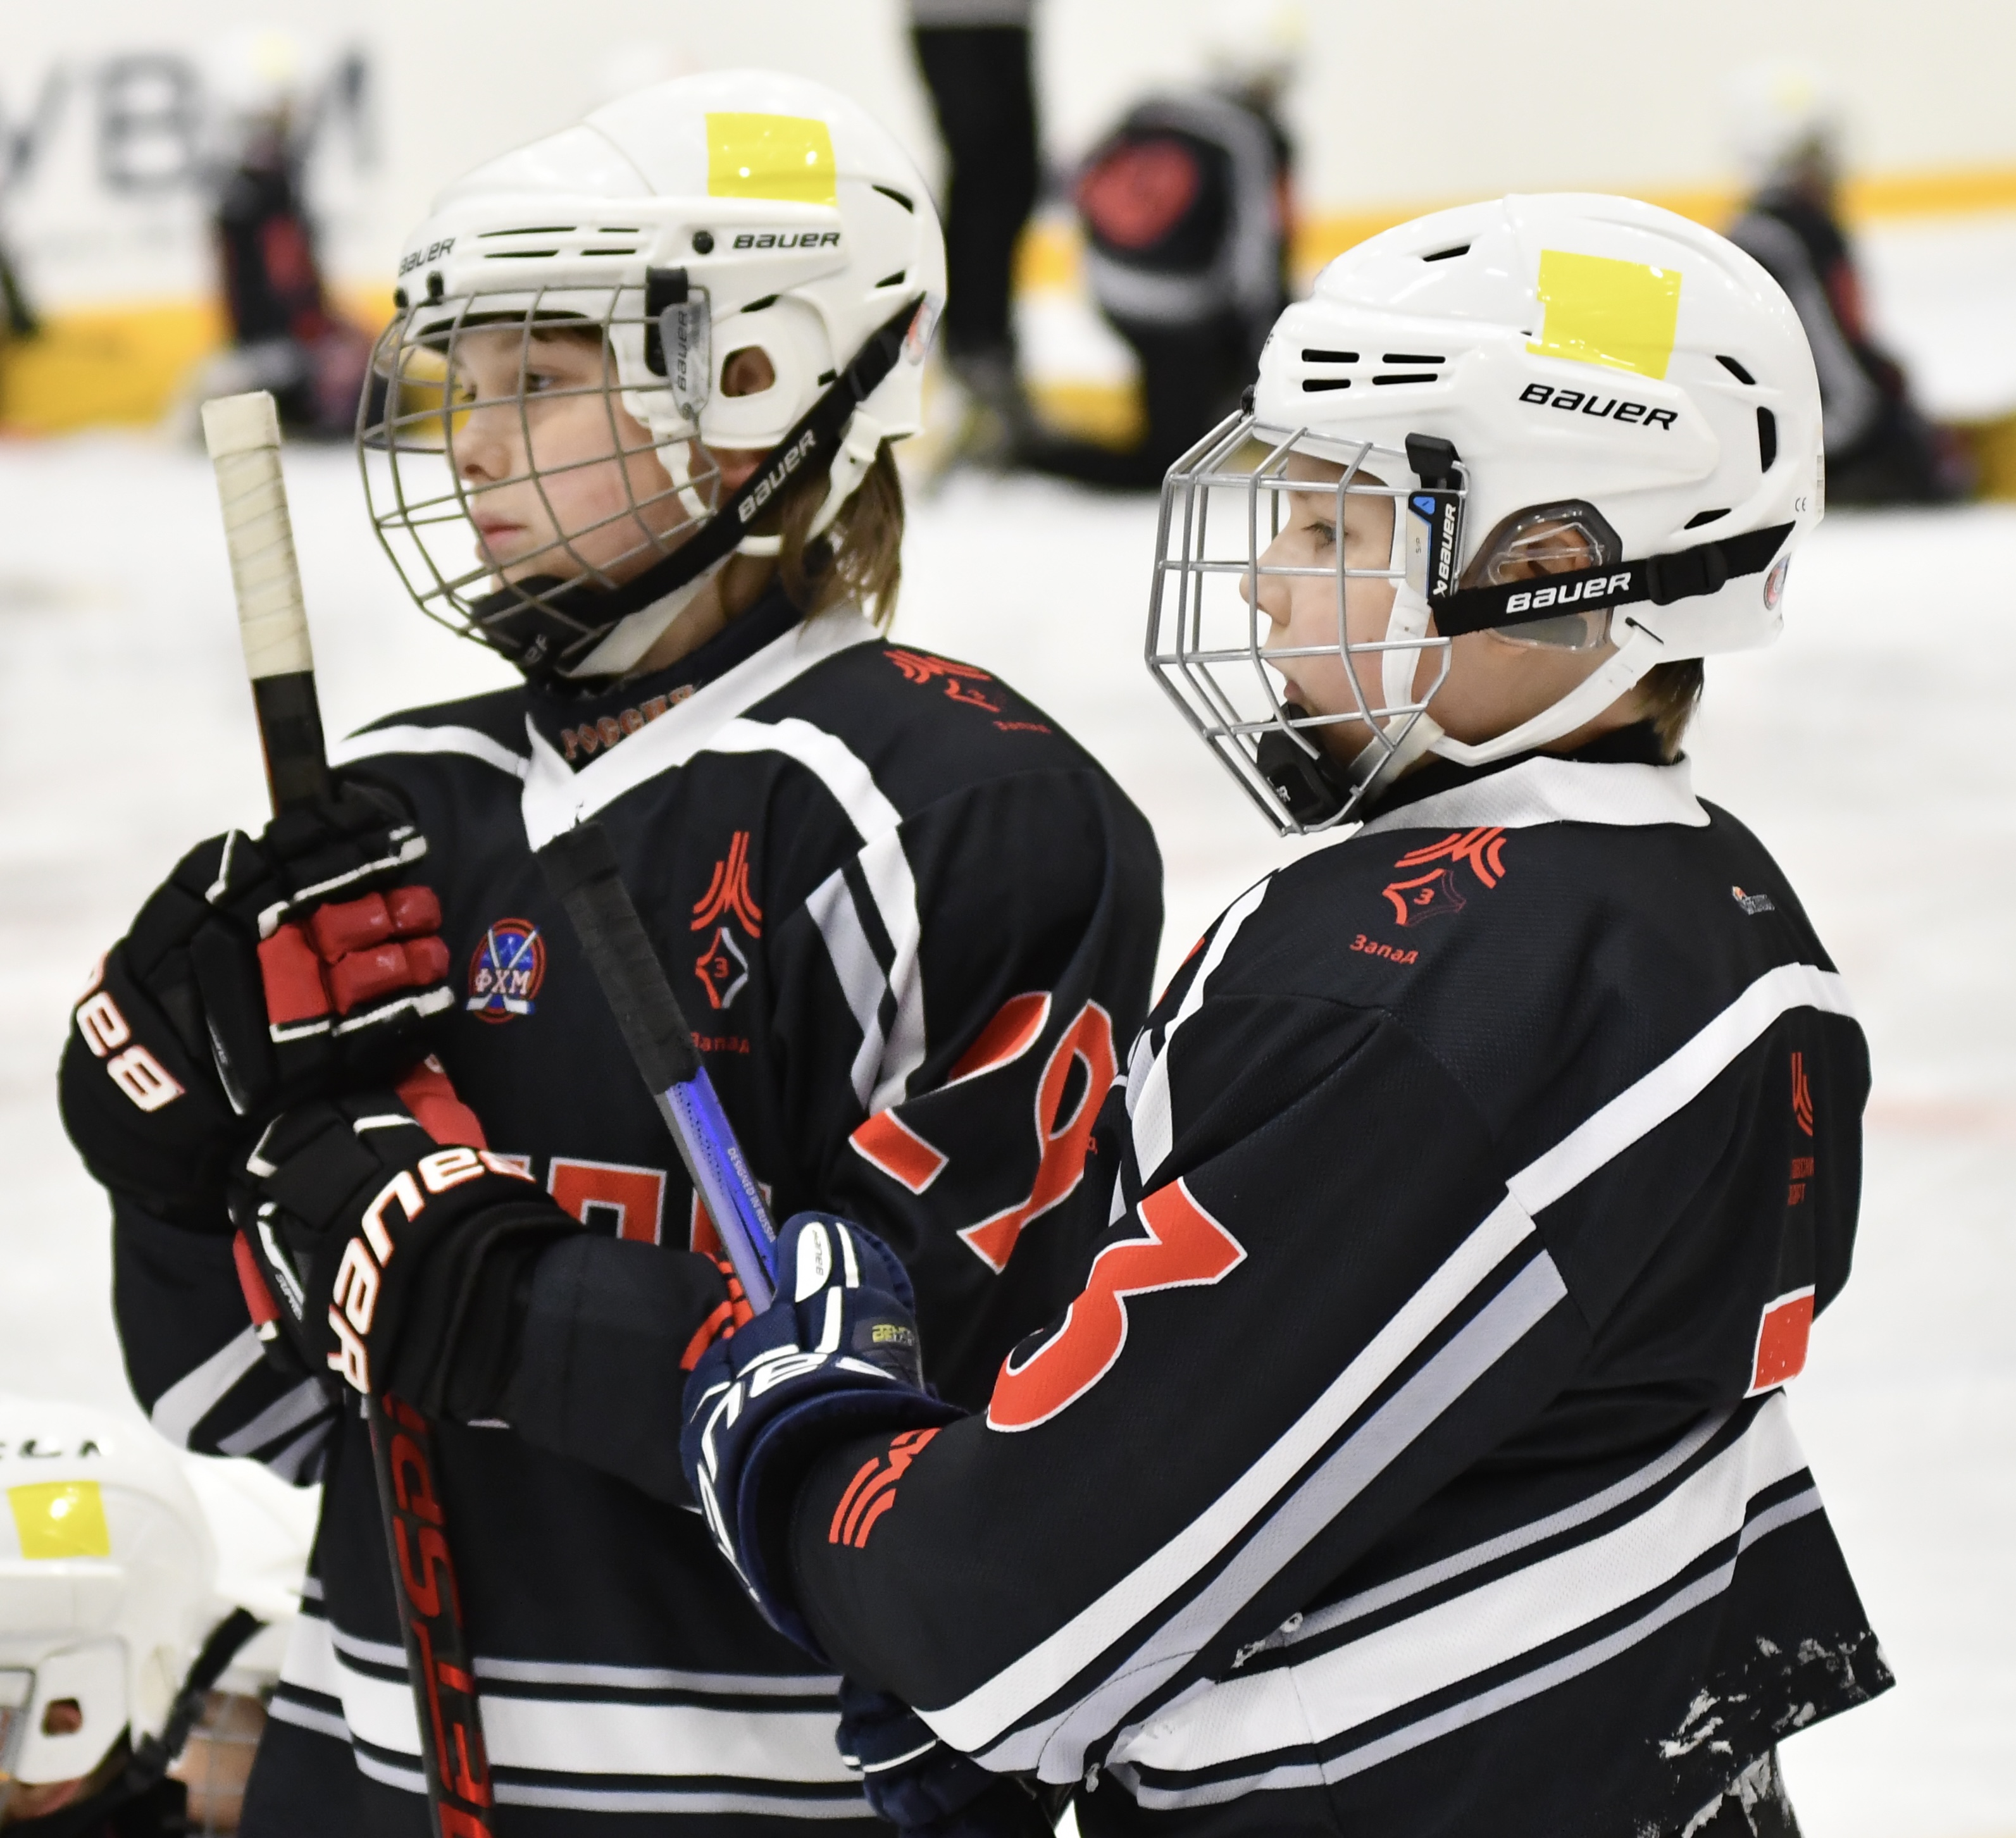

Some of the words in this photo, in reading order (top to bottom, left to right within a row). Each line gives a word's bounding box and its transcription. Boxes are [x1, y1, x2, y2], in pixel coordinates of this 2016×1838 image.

[398, 237, 456, 278] BAUER
[733, 232, 841, 249] BAUER
[677, 310, 688, 392] BAUER
[1519, 383, 1678, 430] BAUER
[738, 429, 817, 523] BAUER
[1438, 503, 1457, 580] BAUER
[1506, 572, 1631, 614] BAUER
[1350, 934, 1419, 966] Запад
[475, 968, 530, 996] ФХМ
[728, 1147, 755, 1196] DESIGNED
[750, 1195, 760, 1208] IN
[756, 1208, 777, 1243] RUSSIA
